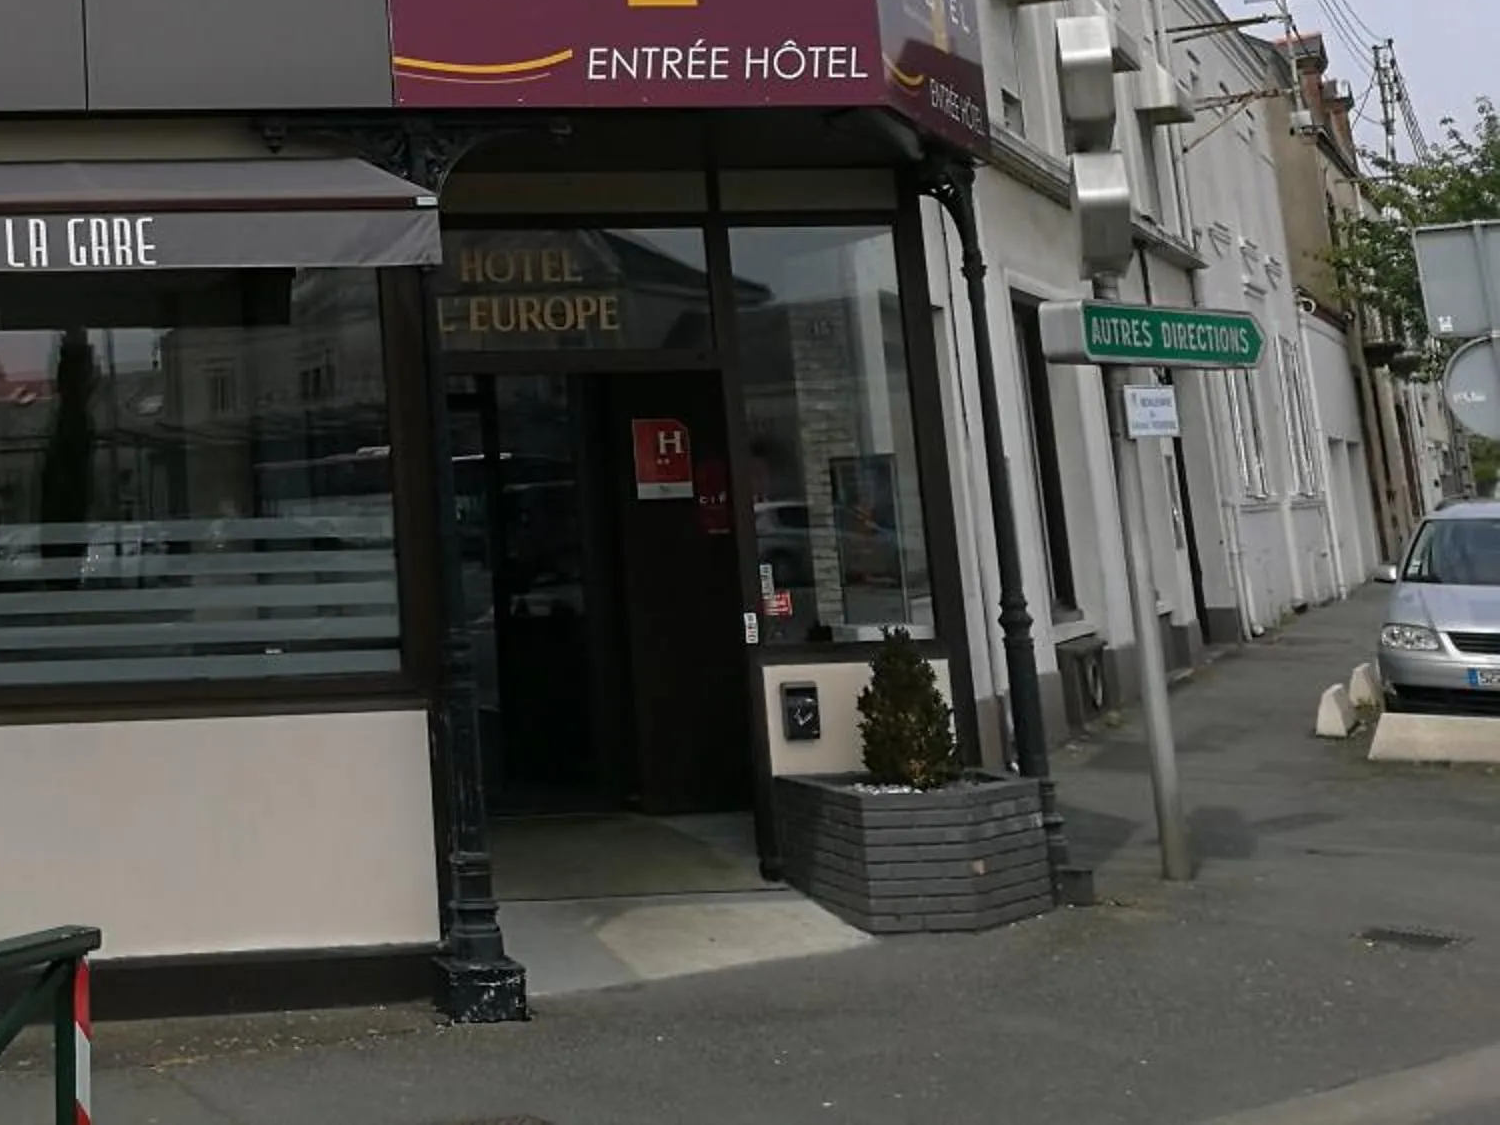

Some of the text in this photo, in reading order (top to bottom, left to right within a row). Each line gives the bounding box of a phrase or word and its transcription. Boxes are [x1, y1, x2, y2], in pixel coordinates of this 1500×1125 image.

[587, 38, 869, 81] ENTRÉE HÔTEL
[5, 218, 49, 268] LA
[67, 216, 158, 266] GARE
[1092, 316, 1250, 354] AUTRES DIRECTIONS
[658, 431, 682, 454] H
